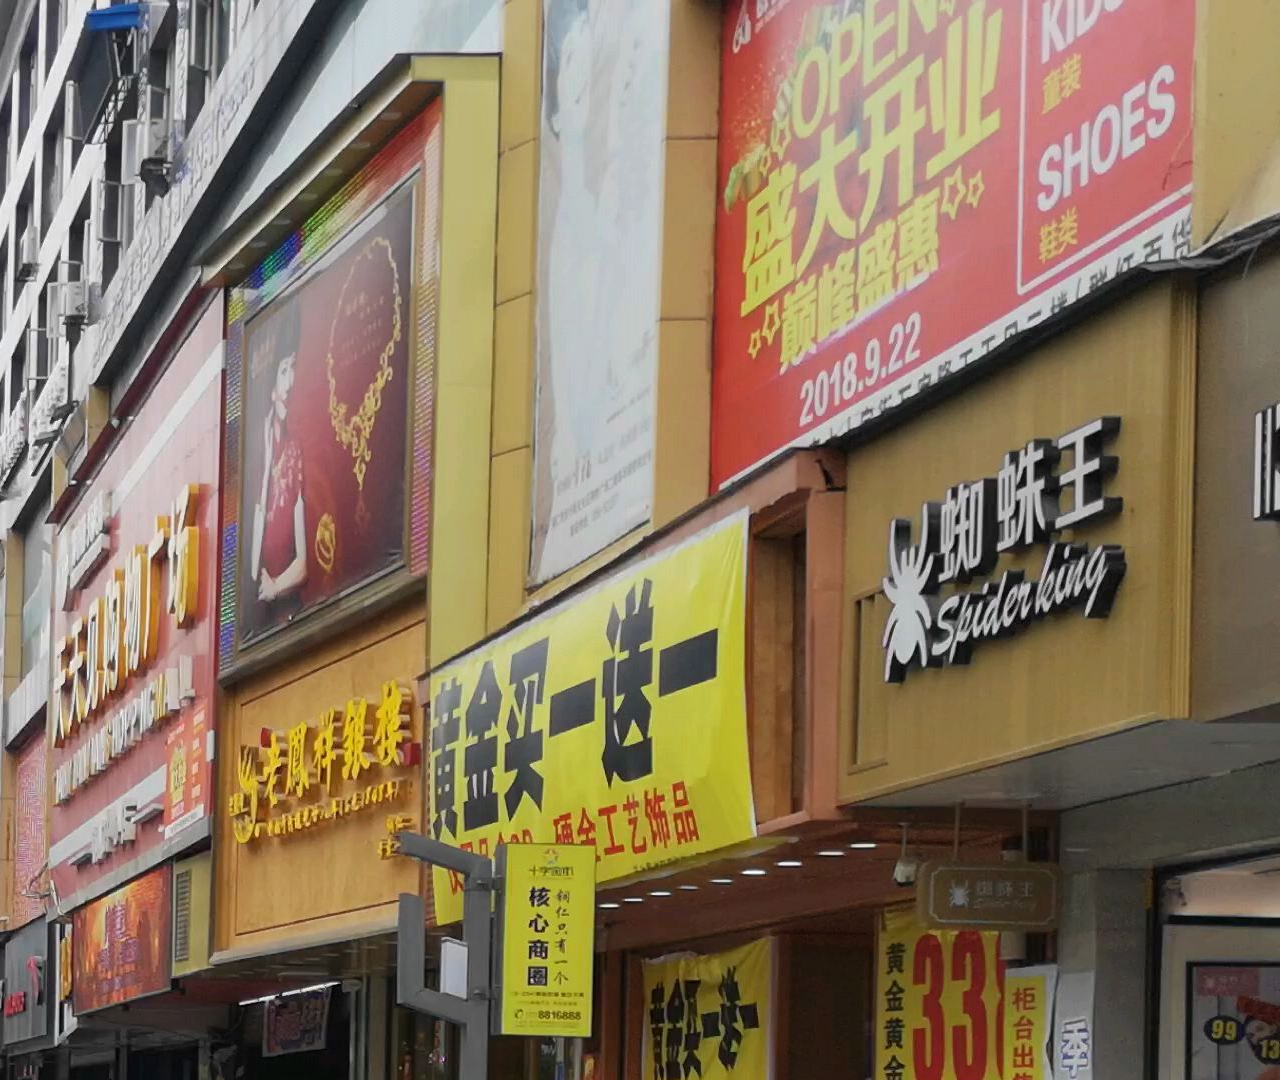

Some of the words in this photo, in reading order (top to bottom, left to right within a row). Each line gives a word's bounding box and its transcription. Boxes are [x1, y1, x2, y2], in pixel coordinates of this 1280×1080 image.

[1041, 0, 1125, 64] KID
[1041, 53, 1082, 114] 童装
[742, 5, 1003, 318] 盛大开业
[1038, 65, 1176, 213] SHOES
[780, 194, 939, 367] 巅峰盛惠
[1039, 207, 1079, 263] 鞋类
[800, 313, 922, 428] 2018.9.22
[938, 418, 1105, 583] 蜘蛛王
[430, 577, 718, 839] 黄金买一送一
[528, 885, 551, 987] 核心商圈
